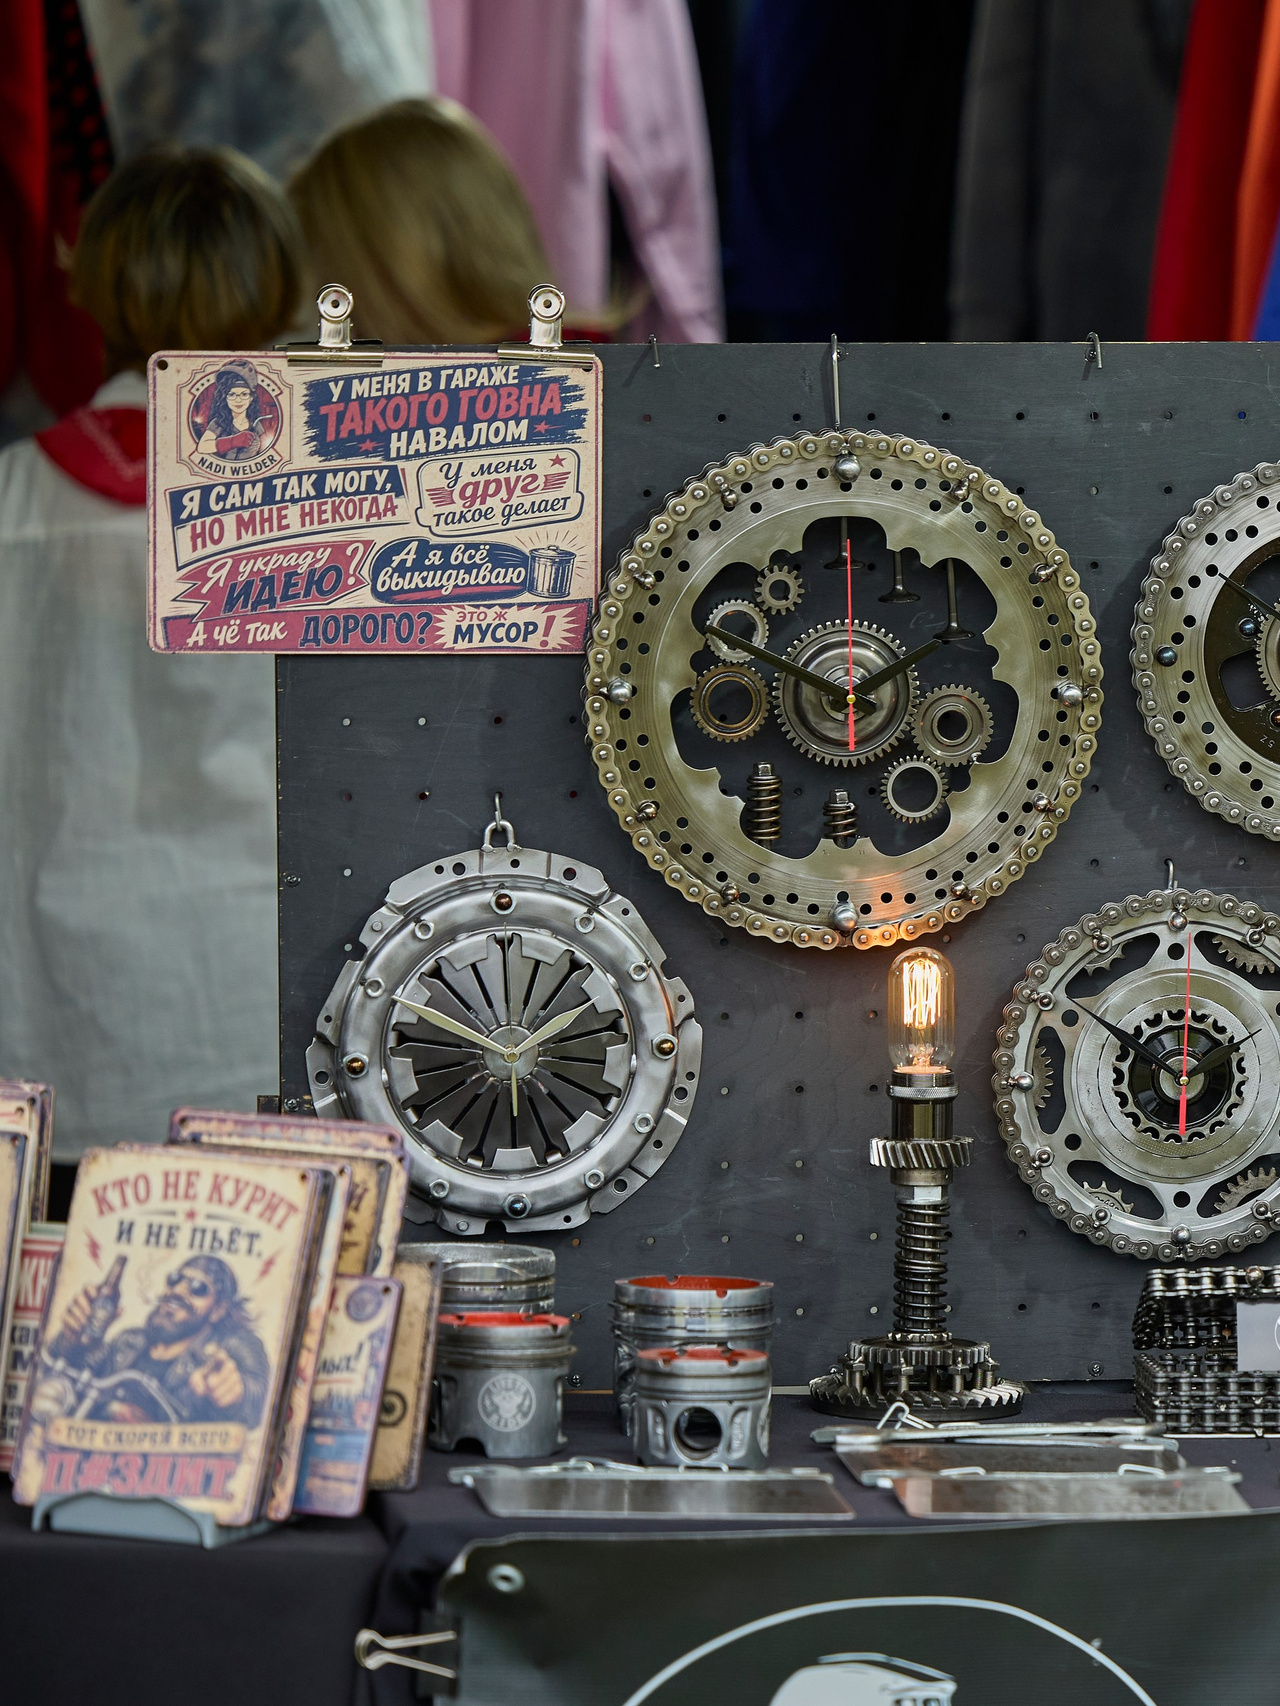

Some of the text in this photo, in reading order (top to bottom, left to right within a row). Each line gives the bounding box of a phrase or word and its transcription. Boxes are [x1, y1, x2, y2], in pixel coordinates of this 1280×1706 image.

[328, 365, 520, 402] У МЕНЯ В ГАРАЖЕ
[319, 382, 562, 443] ТАКОГО ГОВНА
[389, 418, 530, 459] НАВАЛОМ
[197, 454, 278, 477] NADI WELDER
[439, 457, 538, 489] У меня
[179, 469, 392, 521] Я САМ ТАК МОГУ,
[458, 473, 541, 510] друг
[189, 494, 398, 554] НО МНЕ НЕКОГДА
[432, 496, 571, 528] такое делает
[200, 558, 233, 595] Я
[237, 546, 333, 582] украду
[391, 541, 490, 568] А я всё
[376, 562, 526, 595] выкидываю
[187, 611, 430, 648] А чё так ДОРОГО?
[455, 611, 488, 623] ЭТО
[92, 1173, 151, 1217] КТО
[163, 1170, 200, 1201] НЕ
[207, 1173, 299, 1231] КУРИТ
[116, 1220, 135, 1245] И
[144, 1223, 180, 1249] НЕ
[66, 1425, 229, 1447] ТОТ СКОРЕЙ ВСЕГО
